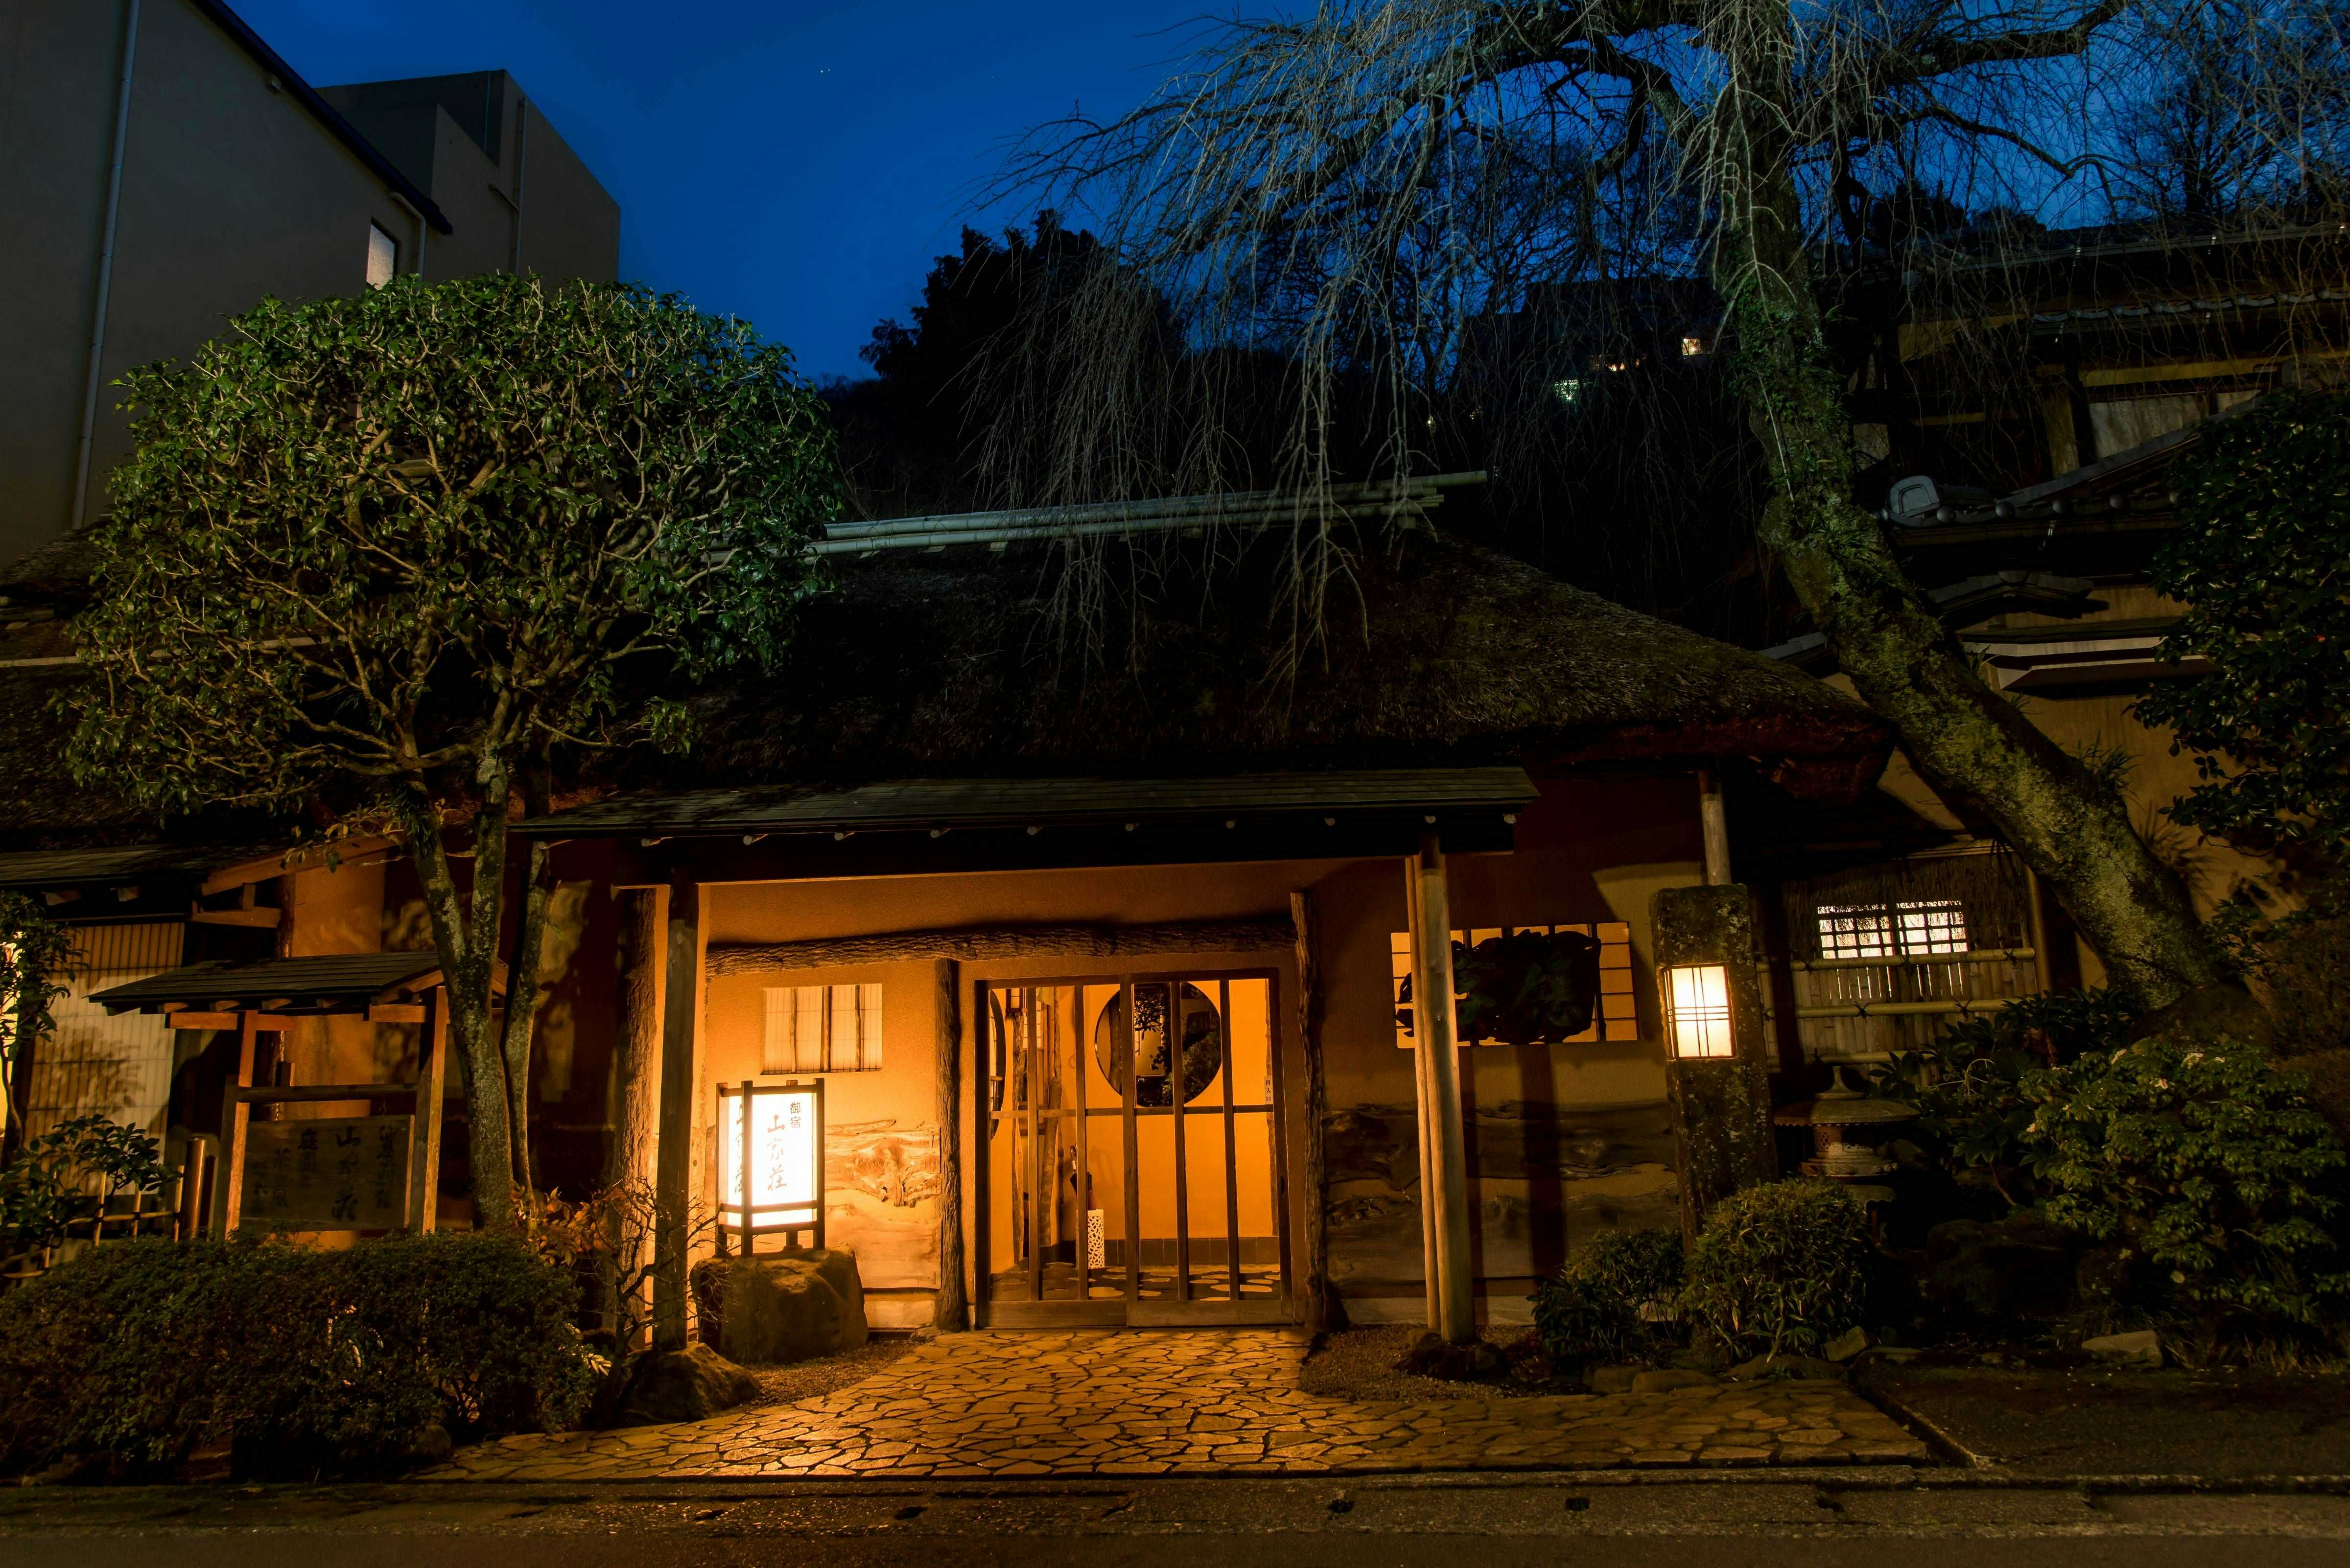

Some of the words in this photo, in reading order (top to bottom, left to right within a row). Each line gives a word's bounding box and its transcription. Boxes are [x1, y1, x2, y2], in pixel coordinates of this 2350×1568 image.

[790, 1102, 800, 1128] 御宿
[767, 1115, 787, 1192] 山家荘
